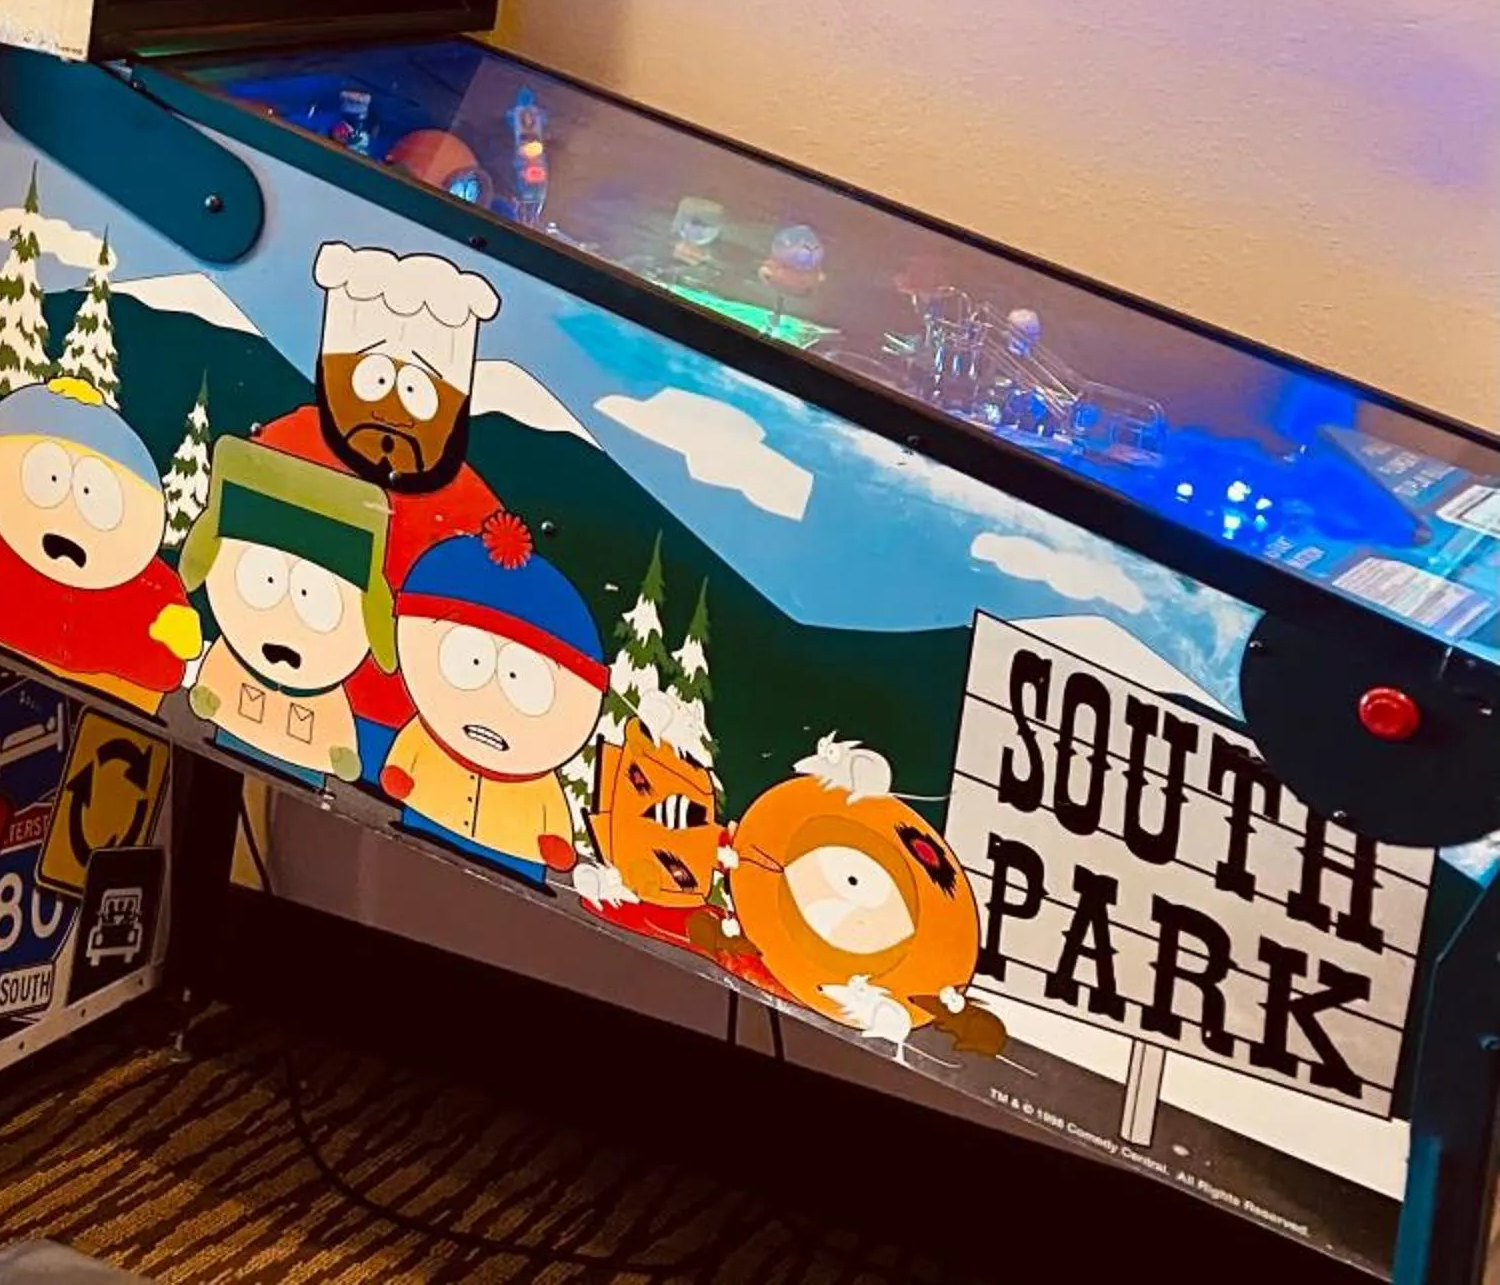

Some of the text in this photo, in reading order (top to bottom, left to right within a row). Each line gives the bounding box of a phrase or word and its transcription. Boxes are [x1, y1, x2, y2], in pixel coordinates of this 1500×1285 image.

[998, 649, 1384, 954] SOUTH
[0, 970, 52, 1006] SOUTH
[973, 831, 1371, 1099] PARK
[990, 1088, 1009, 1104] TM
[1067, 1122, 1119, 1154] Comedy
[1176, 1171, 1195, 1186] All
[1197, 1180, 1241, 1207] Rights
